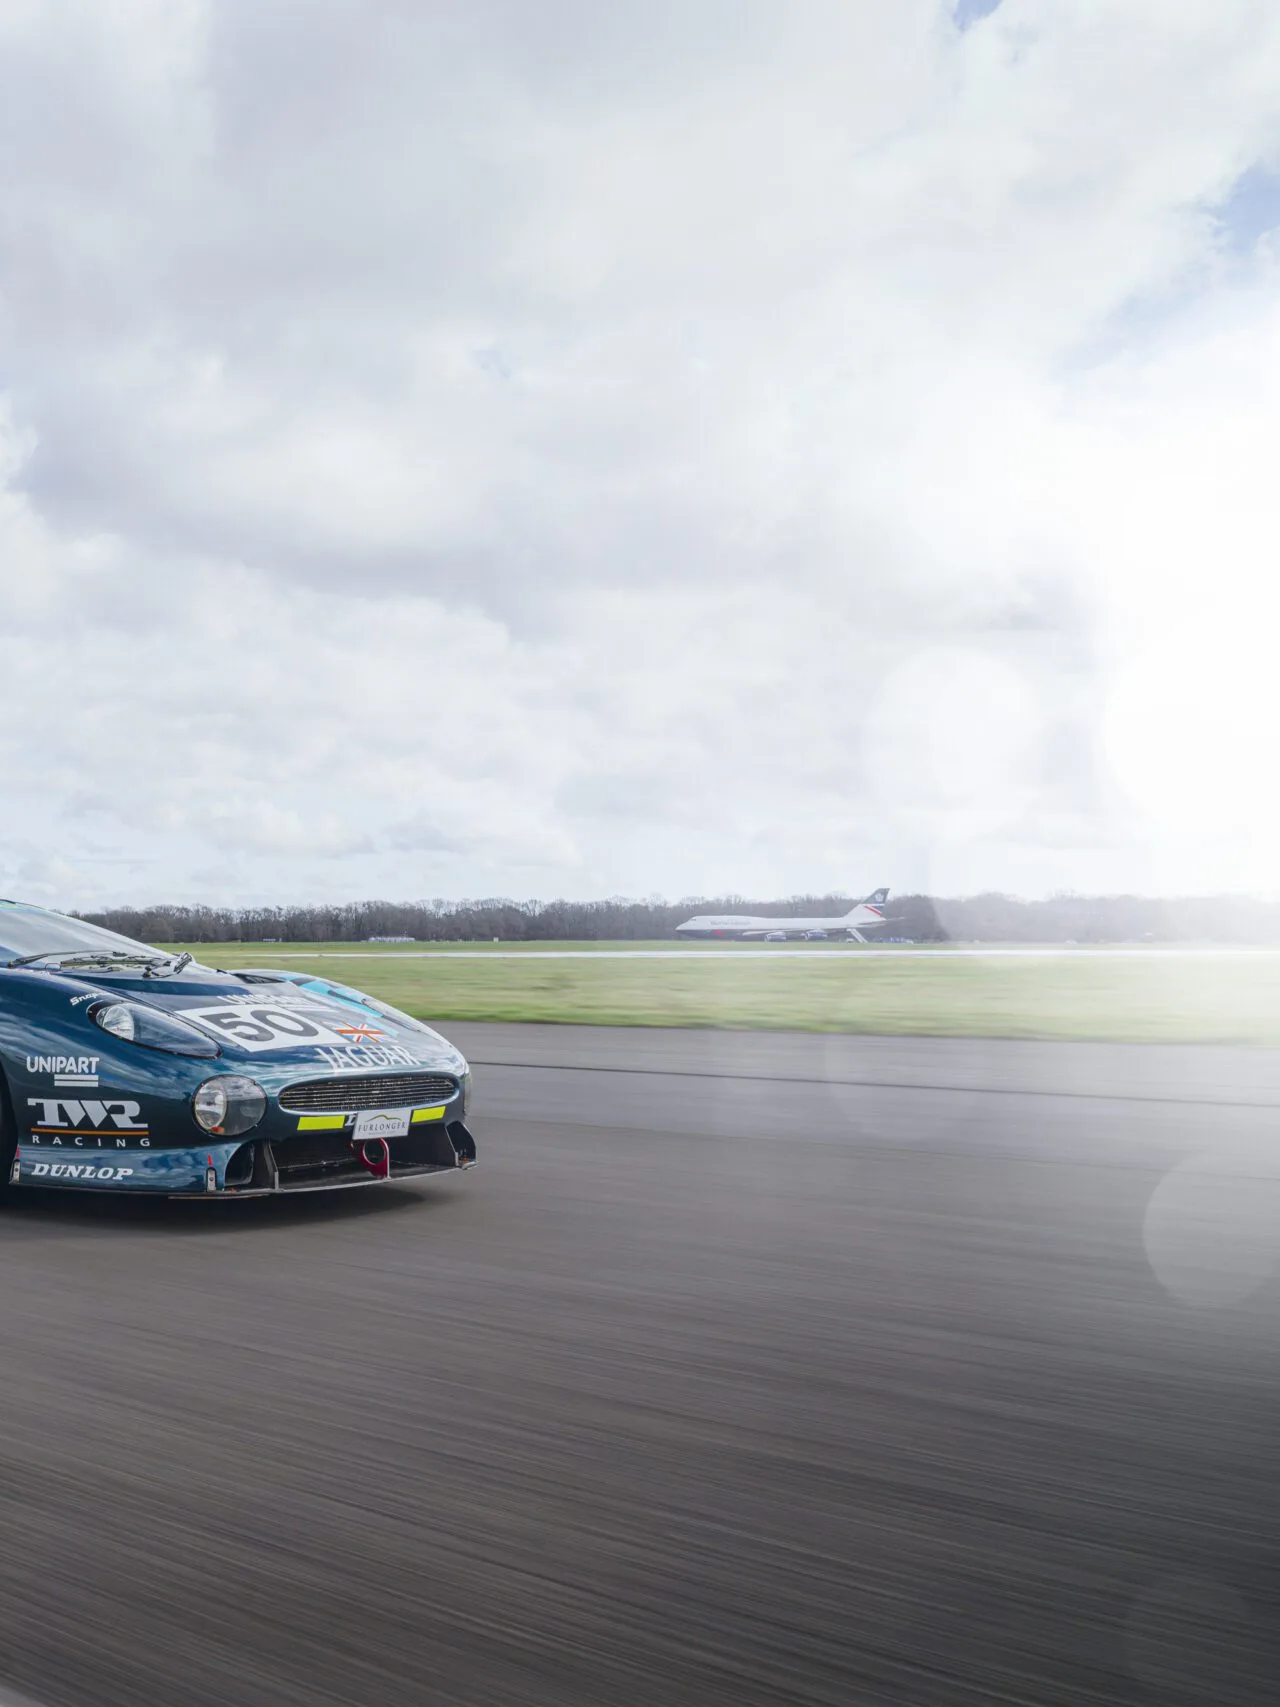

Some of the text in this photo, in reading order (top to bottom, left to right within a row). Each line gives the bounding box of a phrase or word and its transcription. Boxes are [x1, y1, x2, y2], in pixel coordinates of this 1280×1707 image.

[199, 1010, 319, 1041] 50
[26, 1056, 100, 1073] UNIPART
[313, 1045, 422, 1069] JAGUAR
[27, 1098, 148, 1128] TWR
[358, 1121, 406, 1132] FURLONGER
[32, 1135, 151, 1147] RACING
[31, 1163, 134, 1180] DUNLOP
